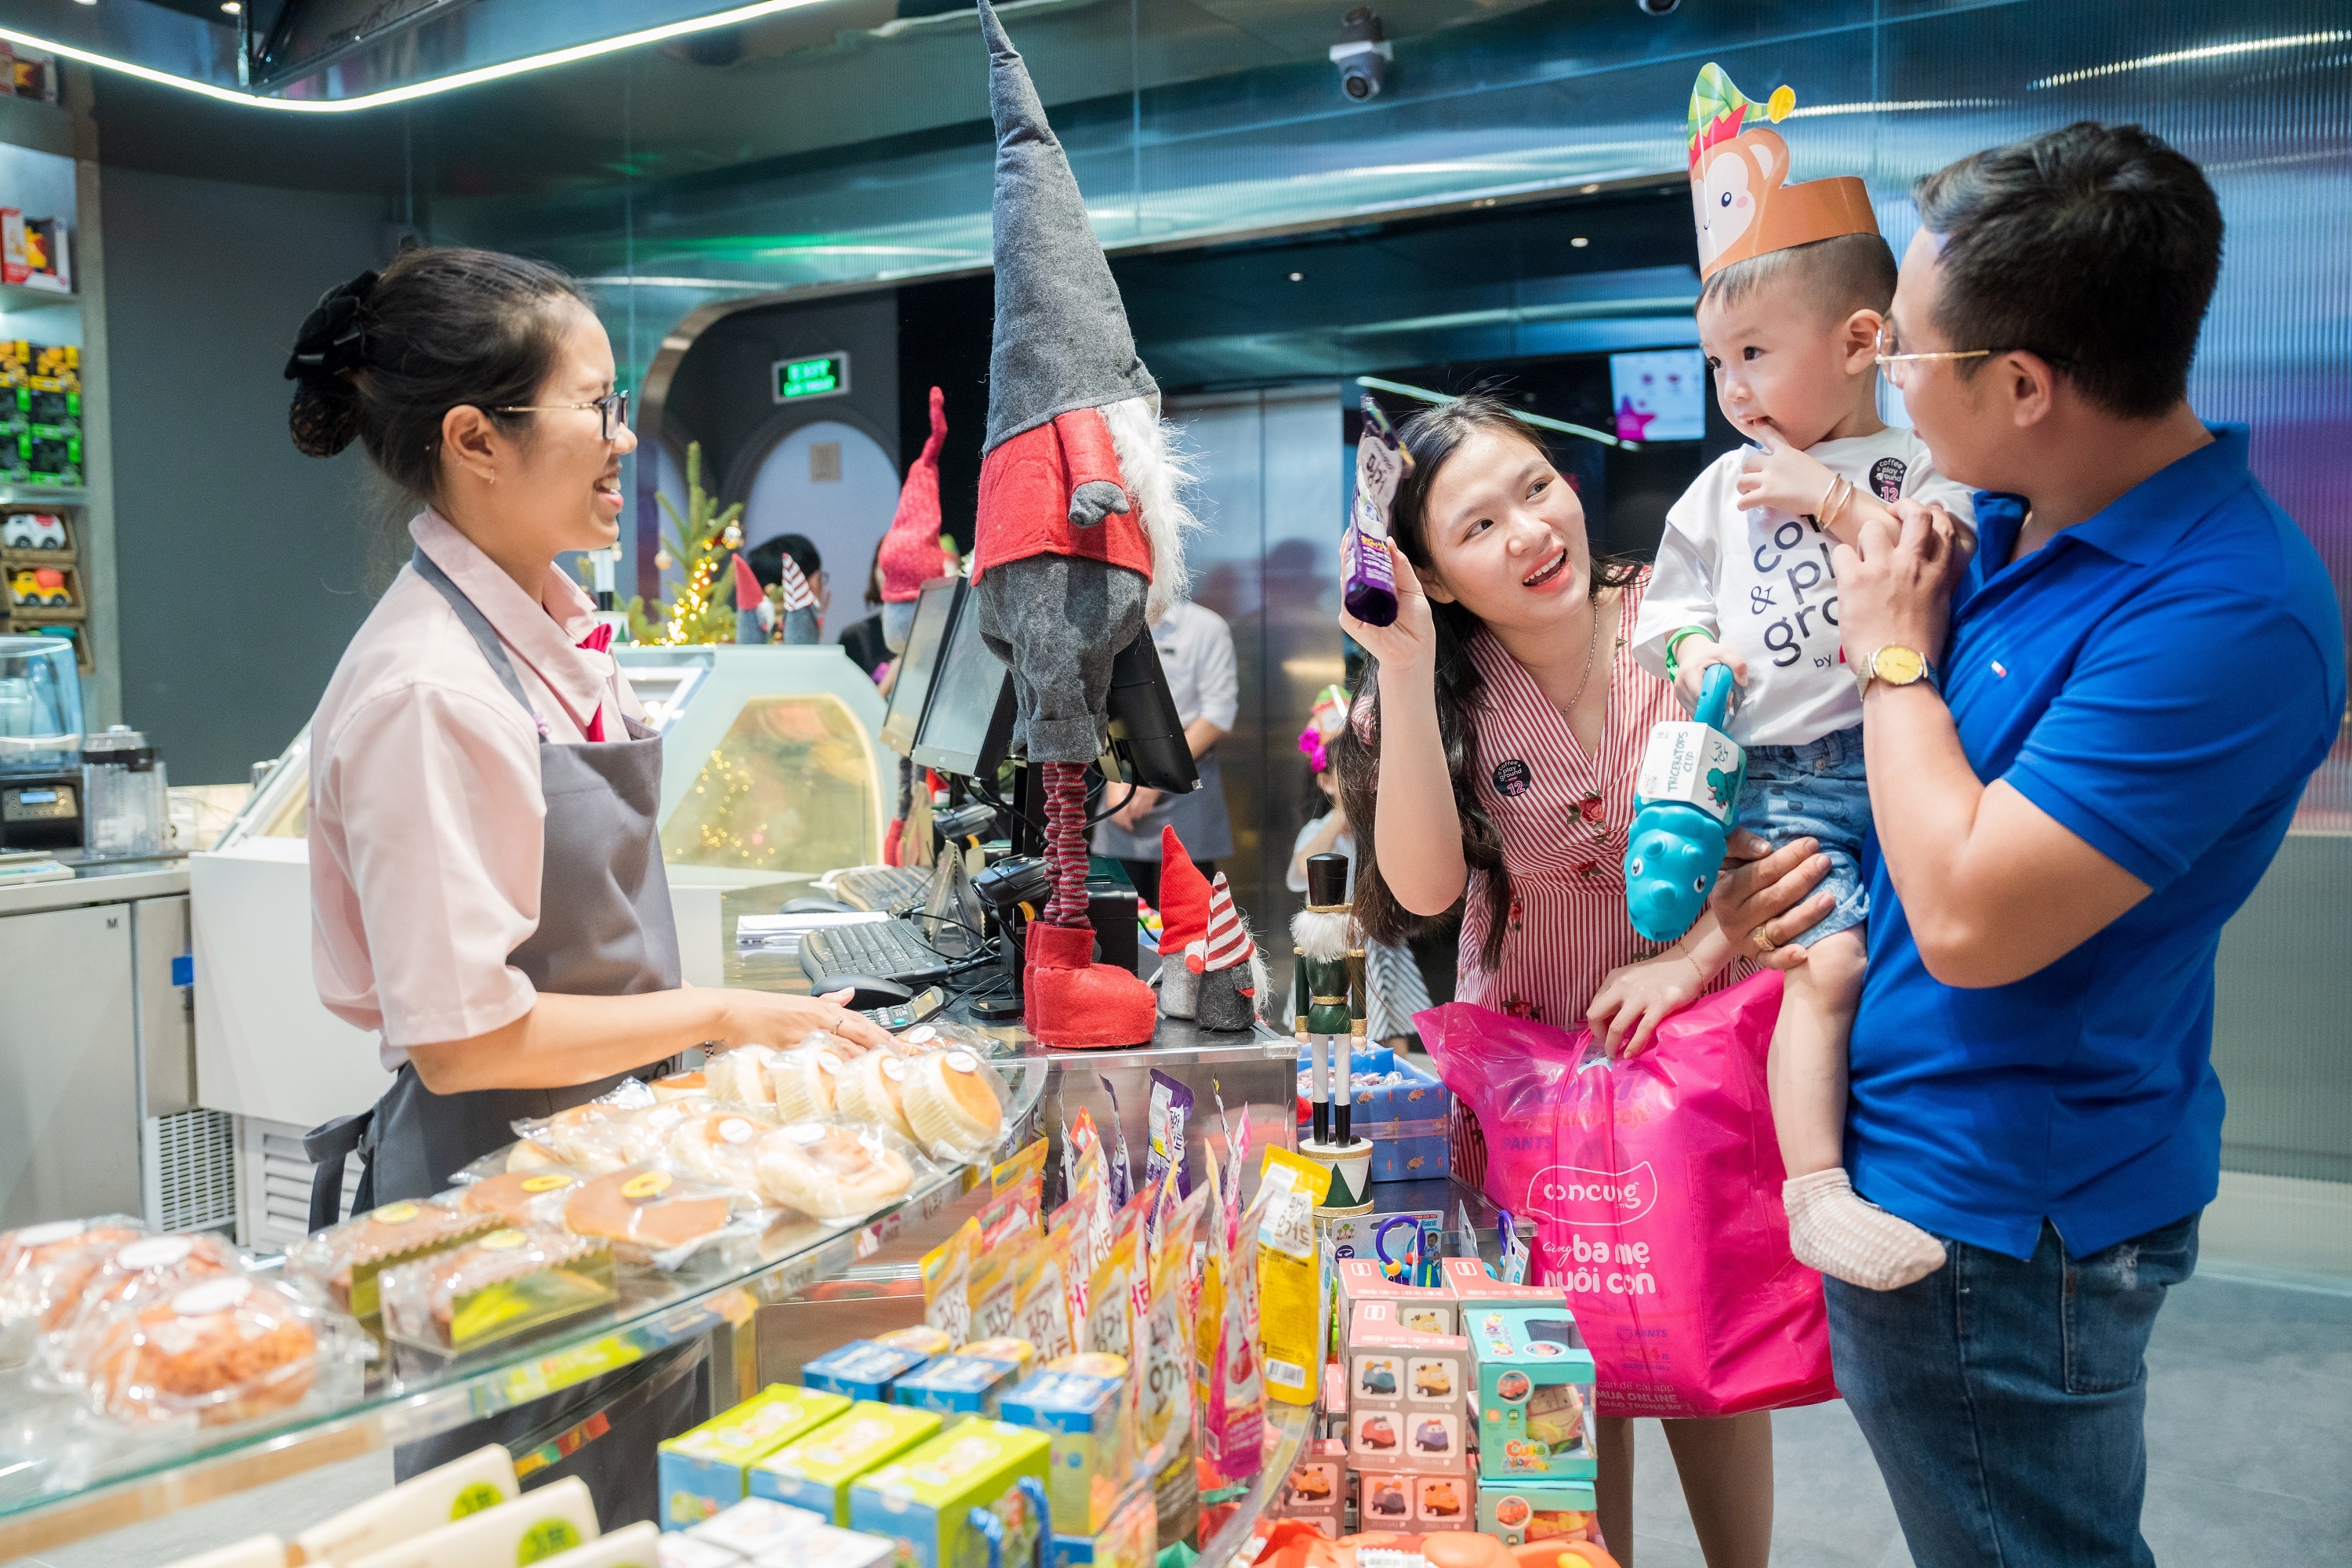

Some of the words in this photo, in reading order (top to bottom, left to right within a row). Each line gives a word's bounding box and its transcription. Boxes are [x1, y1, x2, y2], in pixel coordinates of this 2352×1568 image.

[1879, 459, 1903, 470] coffee
[1882, 467, 1898, 477] play
[1882, 486, 1899, 502] 12
[1751, 586, 1777, 615] &
[1787, 543, 1835, 605] pl
[1764, 596, 1838, 667] gro
[1813, 654, 1831, 669] by
[1498, 760, 1519, 771] coffee
[1668, 731, 1689, 792] TRICERATOPS
[1683, 751, 1695, 772] CLIP
[1499, 768, 1523, 782] ground
[1503, 766, 1516, 775] play
[1507, 780, 1526, 795] 12
[1573, 1234, 1610, 1263] ba
[1614, 1242, 1651, 1269] mẹ
[1544, 1266, 1601, 1294] nuôi
[1606, 1272, 1657, 1296] con
[1596, 1390, 1625, 1400] MUA
[1627, 1392, 1679, 1403] ONLINE
[1653, 1384, 1675, 1394] app
[1627, 1402, 1666, 1410] TRONG
